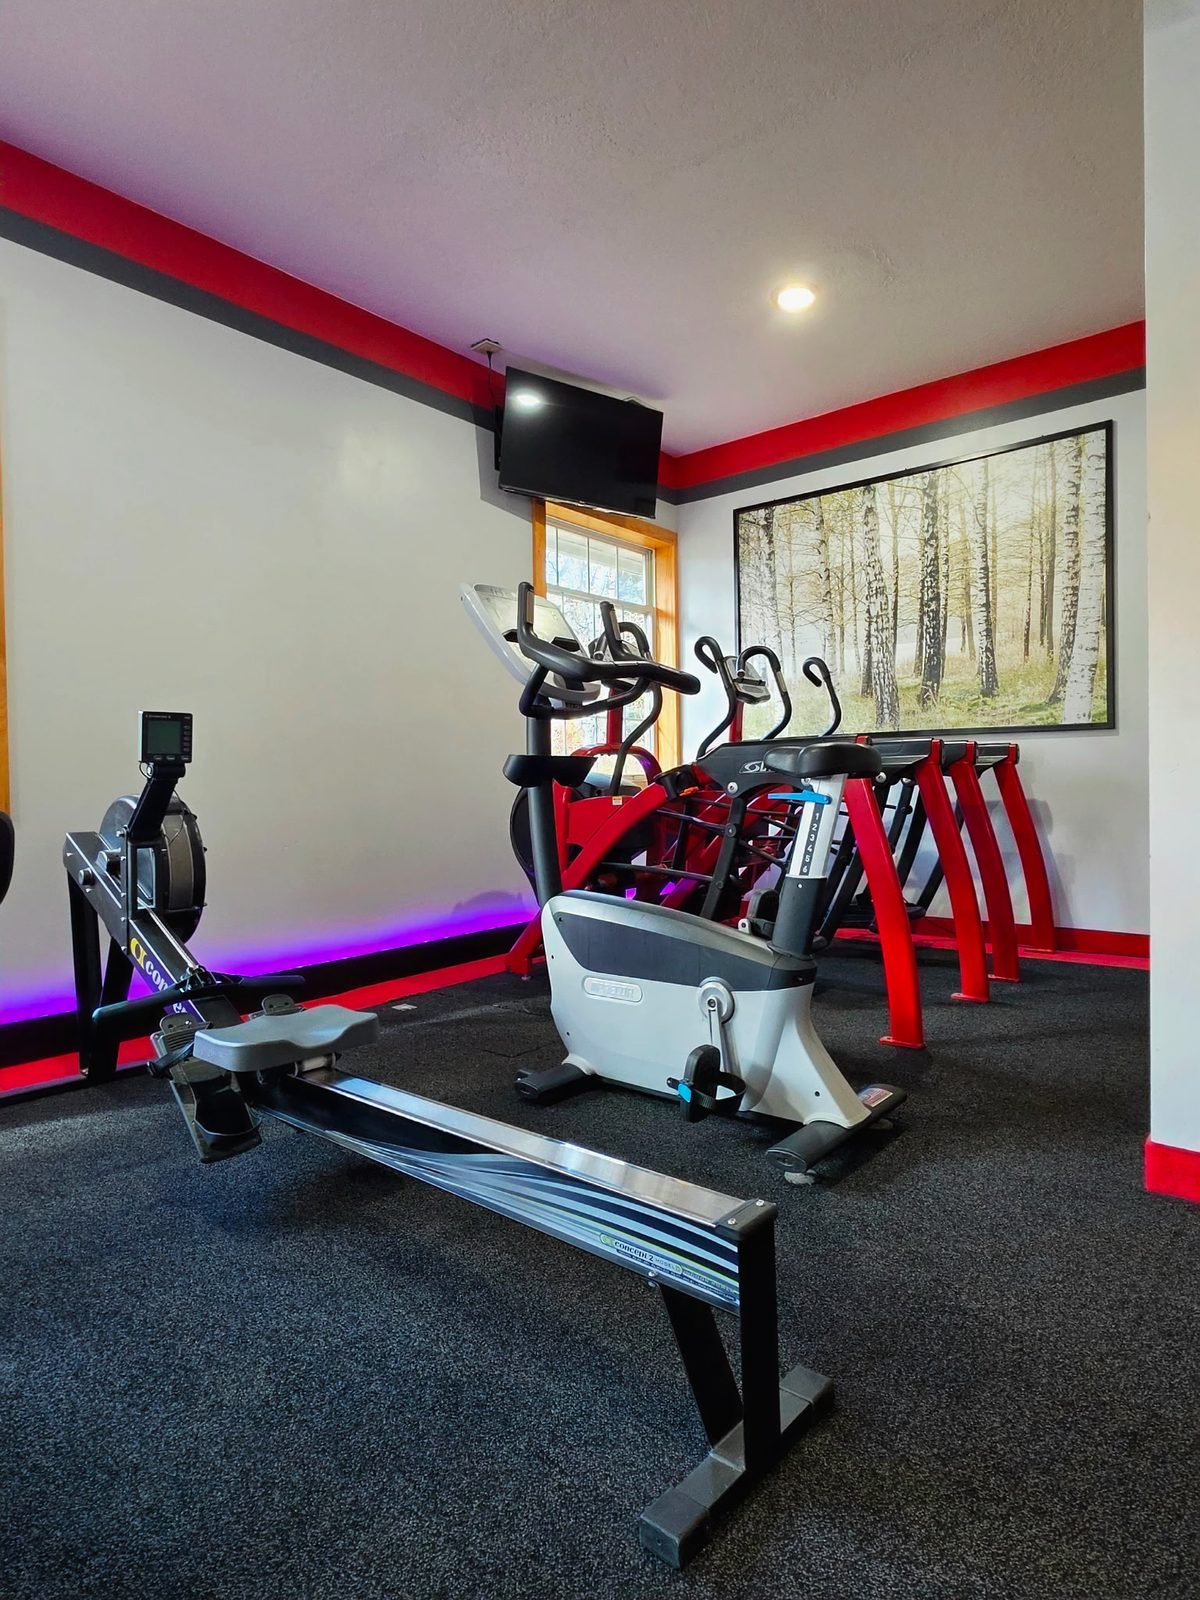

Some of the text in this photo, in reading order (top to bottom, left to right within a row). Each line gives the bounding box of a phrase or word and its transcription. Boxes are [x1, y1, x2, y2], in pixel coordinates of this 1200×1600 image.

[812, 823, 817, 831] 2
[810, 834, 815, 842] 3
[805, 855, 810, 863] 5
